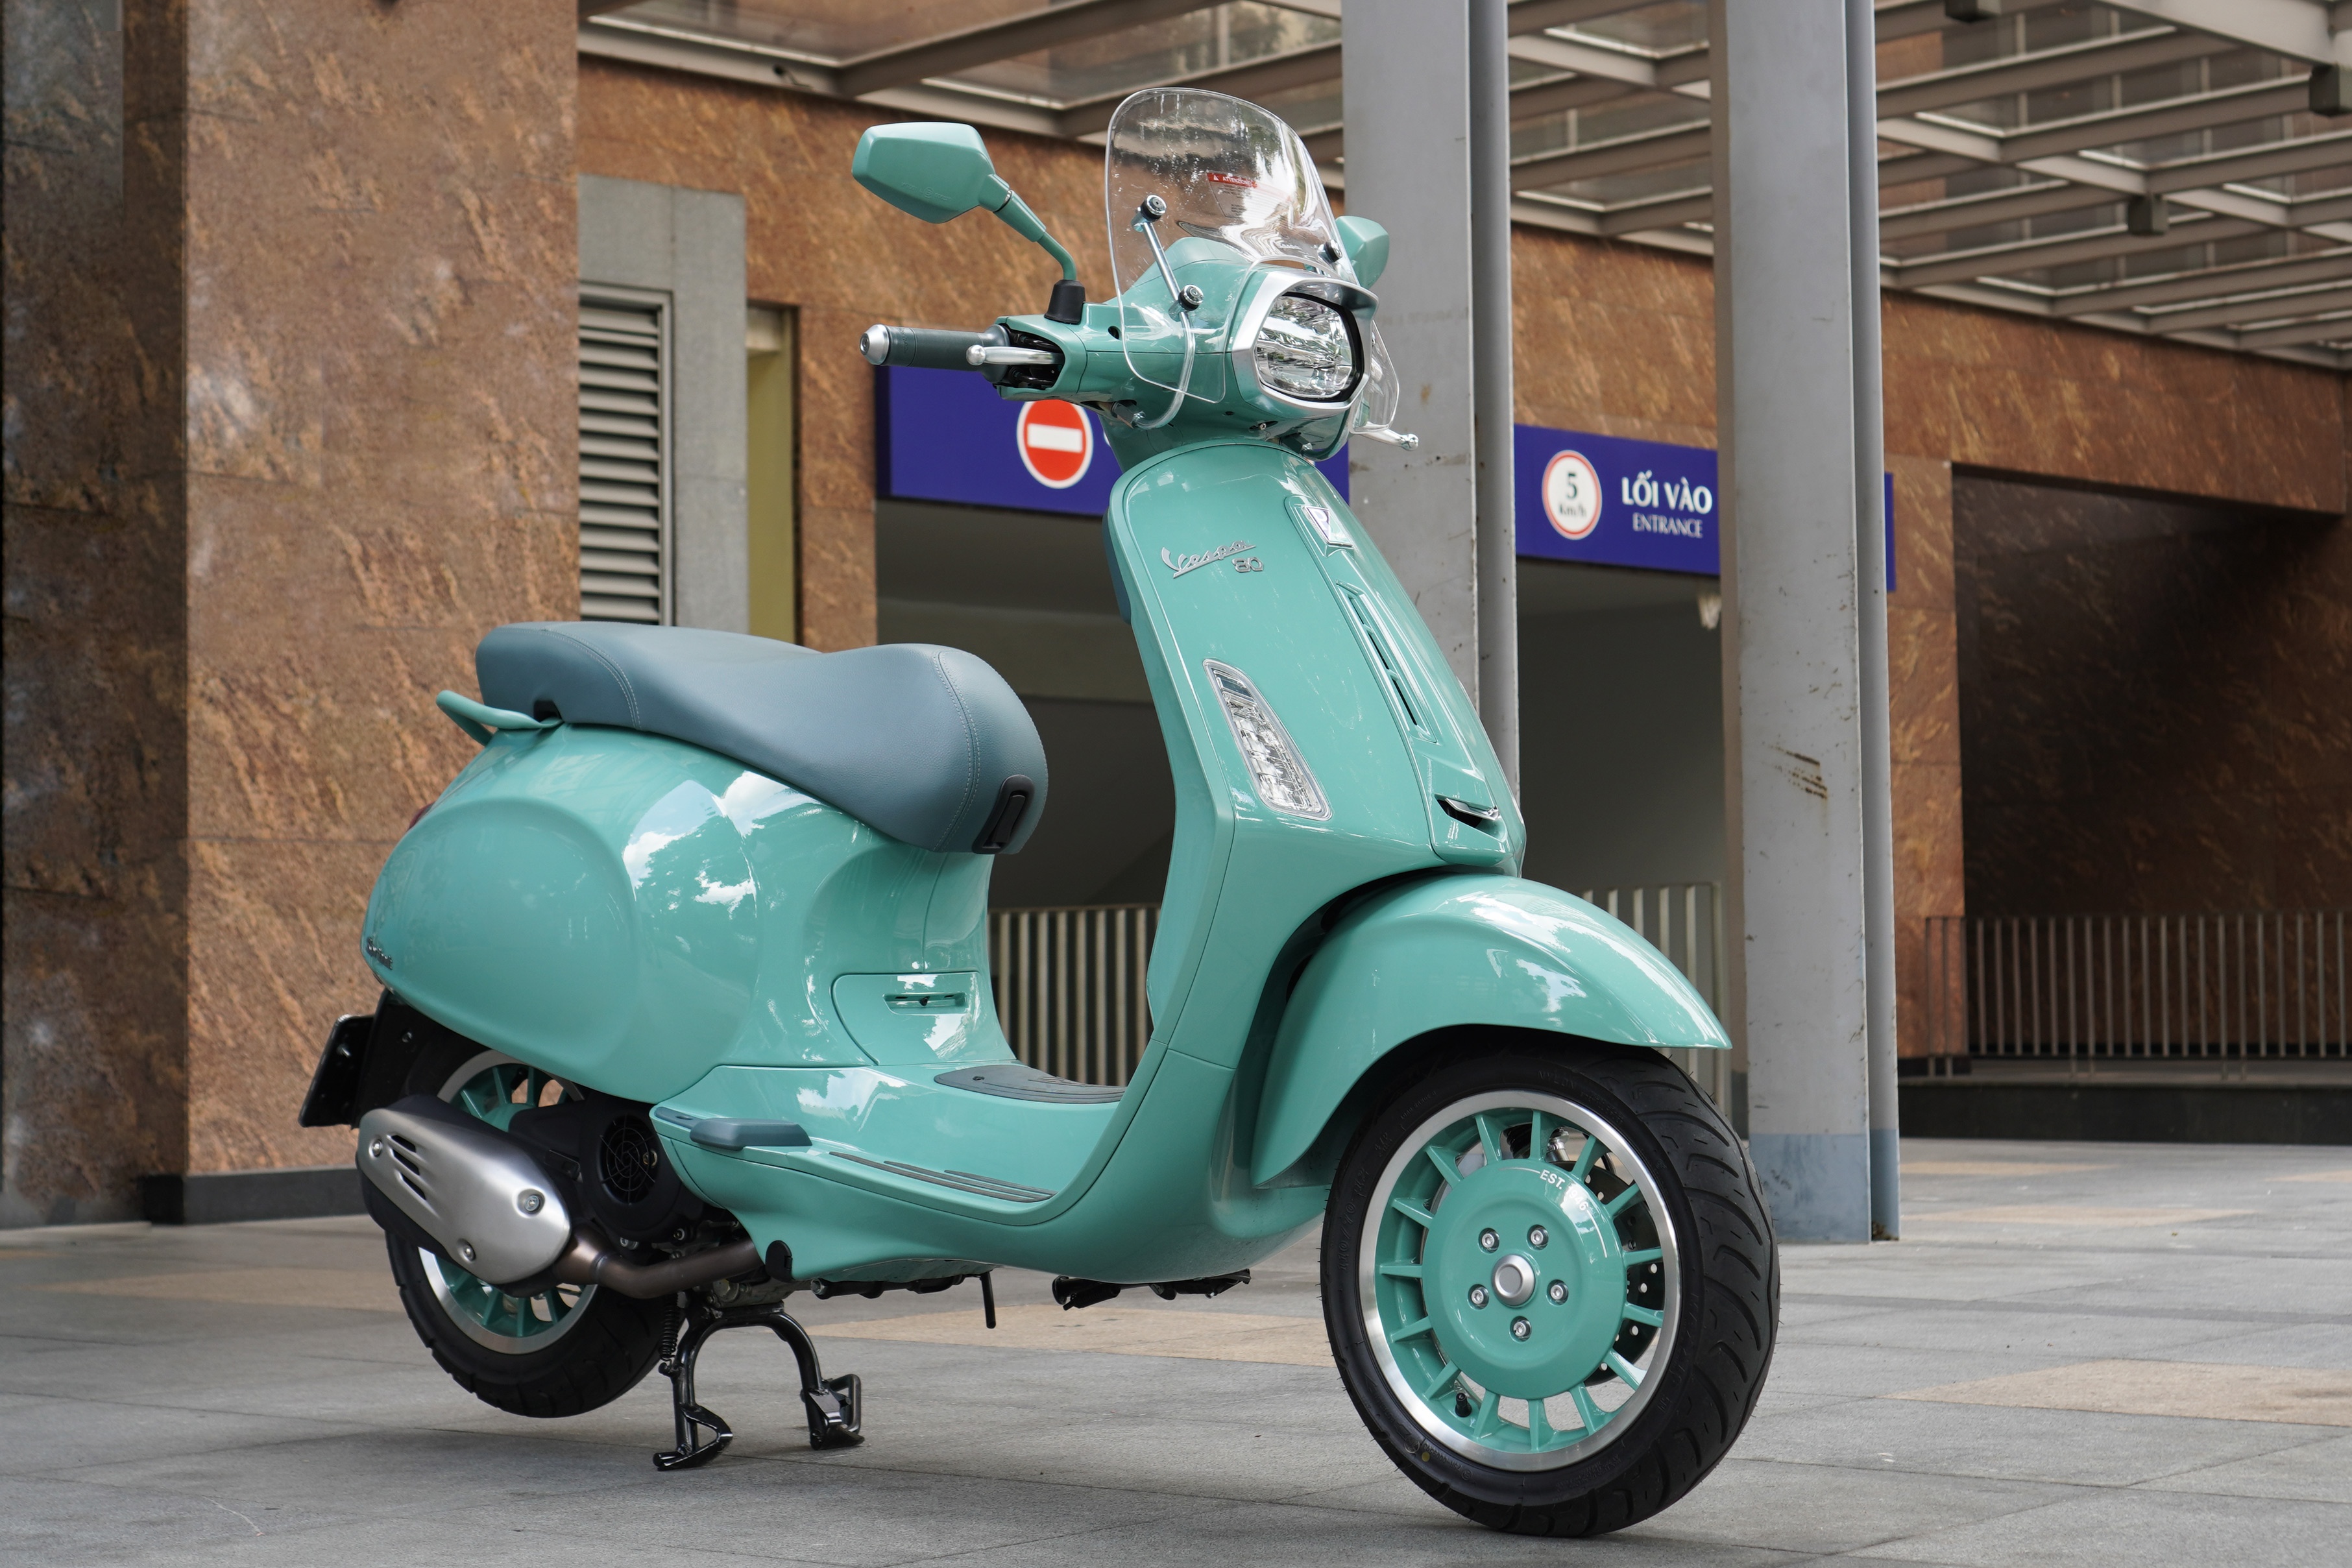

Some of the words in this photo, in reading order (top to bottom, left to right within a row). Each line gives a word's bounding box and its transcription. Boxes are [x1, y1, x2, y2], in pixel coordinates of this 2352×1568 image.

[1566, 472, 1577, 500] 5
[1621, 470, 1659, 508] LỐI
[1663, 476, 1713, 514] VÀO
[1632, 511, 1703, 539] ENTRANCE
[1161, 540, 1256, 579] Vespa
[1540, 1169, 1566, 1190] EST.
